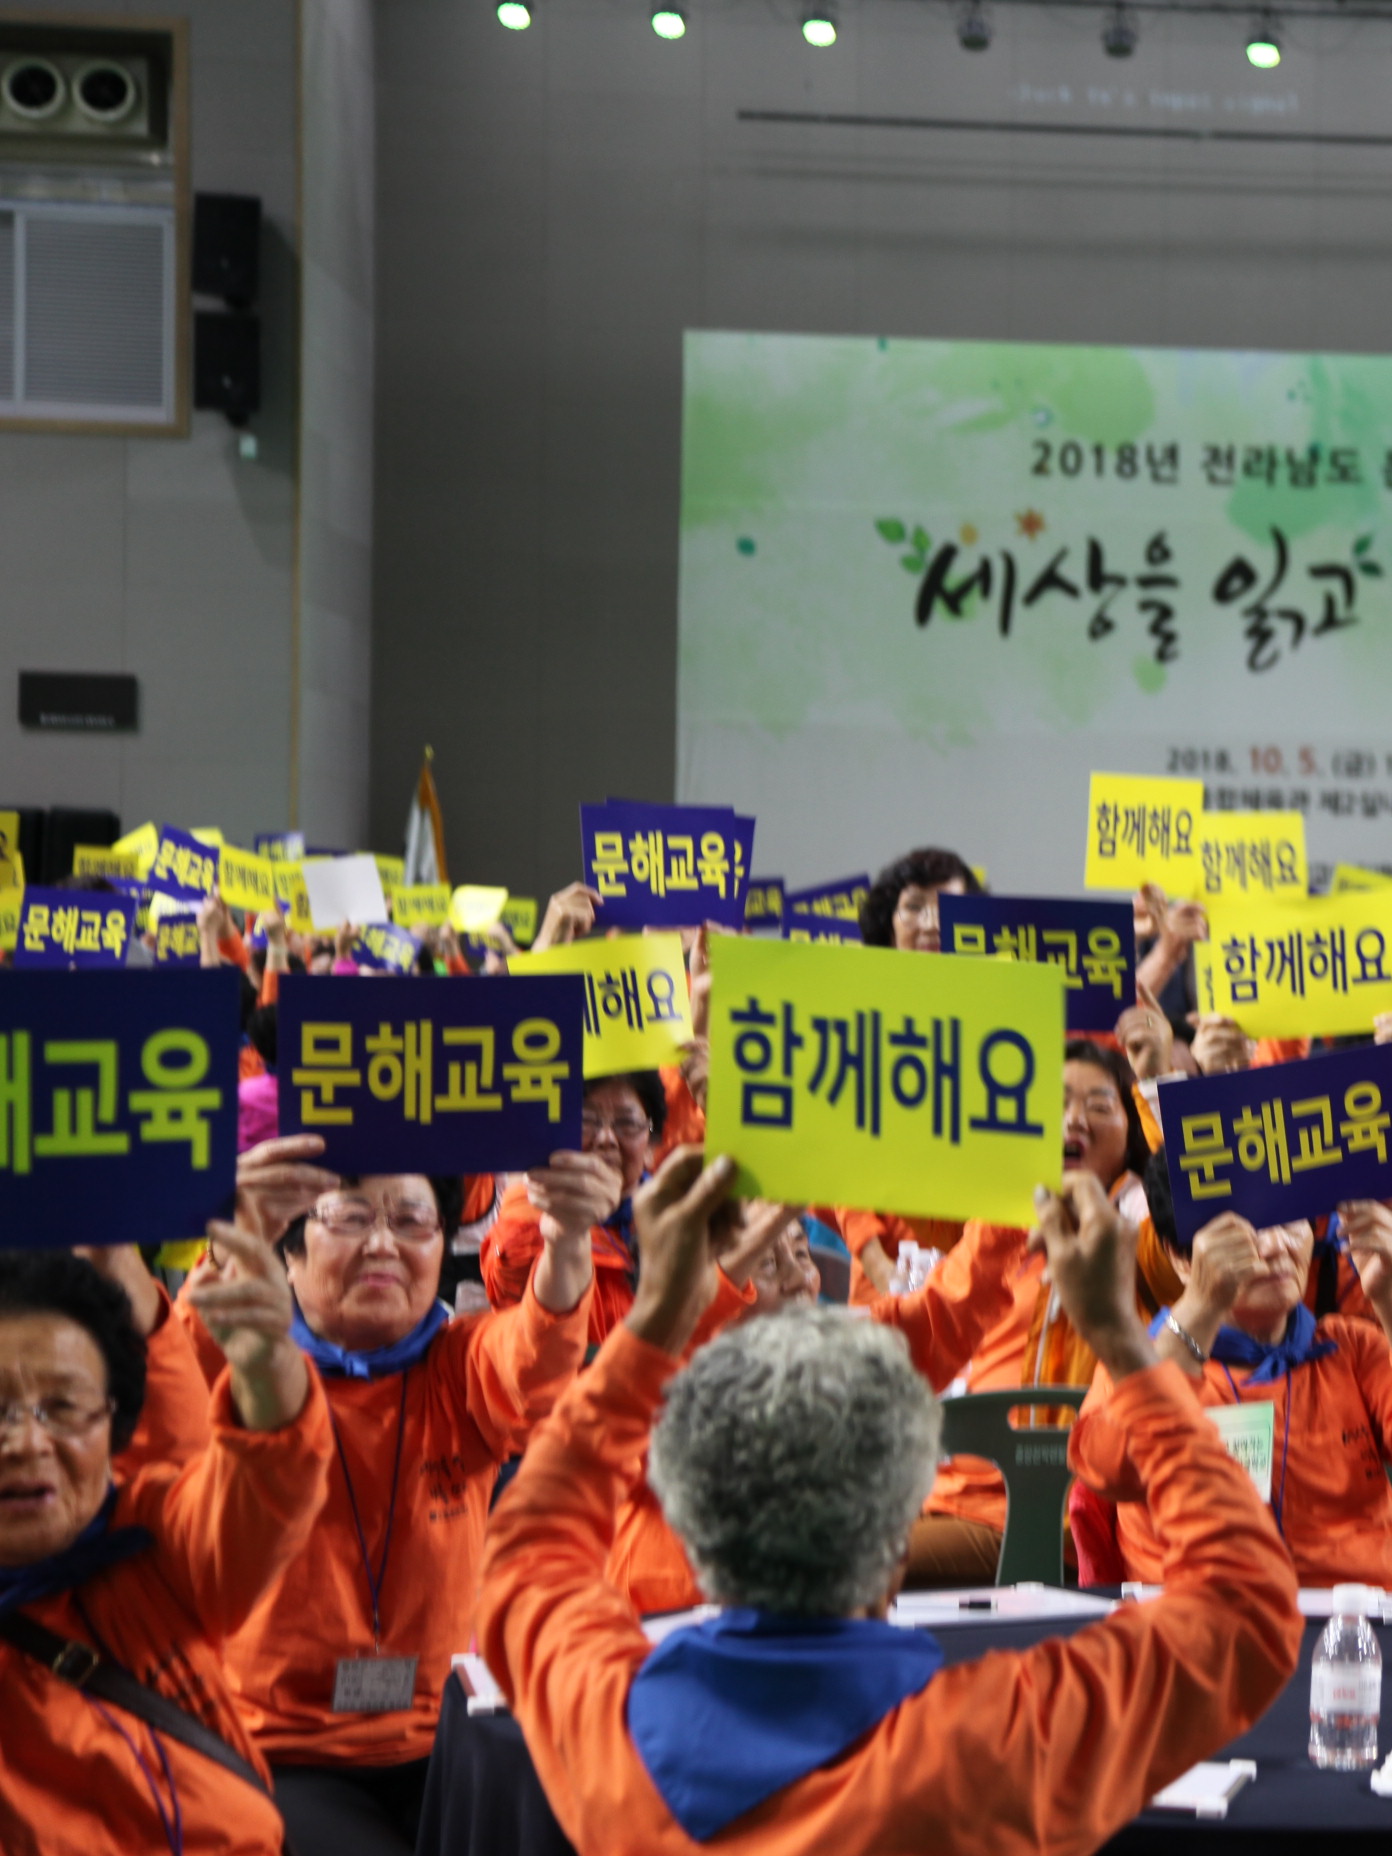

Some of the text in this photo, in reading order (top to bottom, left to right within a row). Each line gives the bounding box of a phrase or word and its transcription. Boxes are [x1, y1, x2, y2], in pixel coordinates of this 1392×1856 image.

[1030, 440, 1180, 484] 2018년
[1201, 443, 1363, 489] 전라남도
[914, 530, 1181, 664] 세상을
[1211, 525, 1360, 673] 읽고
[592, 830, 730, 899] 문해교육
[1096, 798, 1194, 859] 함께해요
[1202, 838, 1302, 895] 함께해요
[23, 904, 127, 960] 문해교육
[1221, 926, 1392, 1003] 함께해요
[292, 1017, 570, 1125] 문해교육
[729, 995, 1045, 1147] 함께해요
[1179, 1080, 1391, 1201] 문해교육
